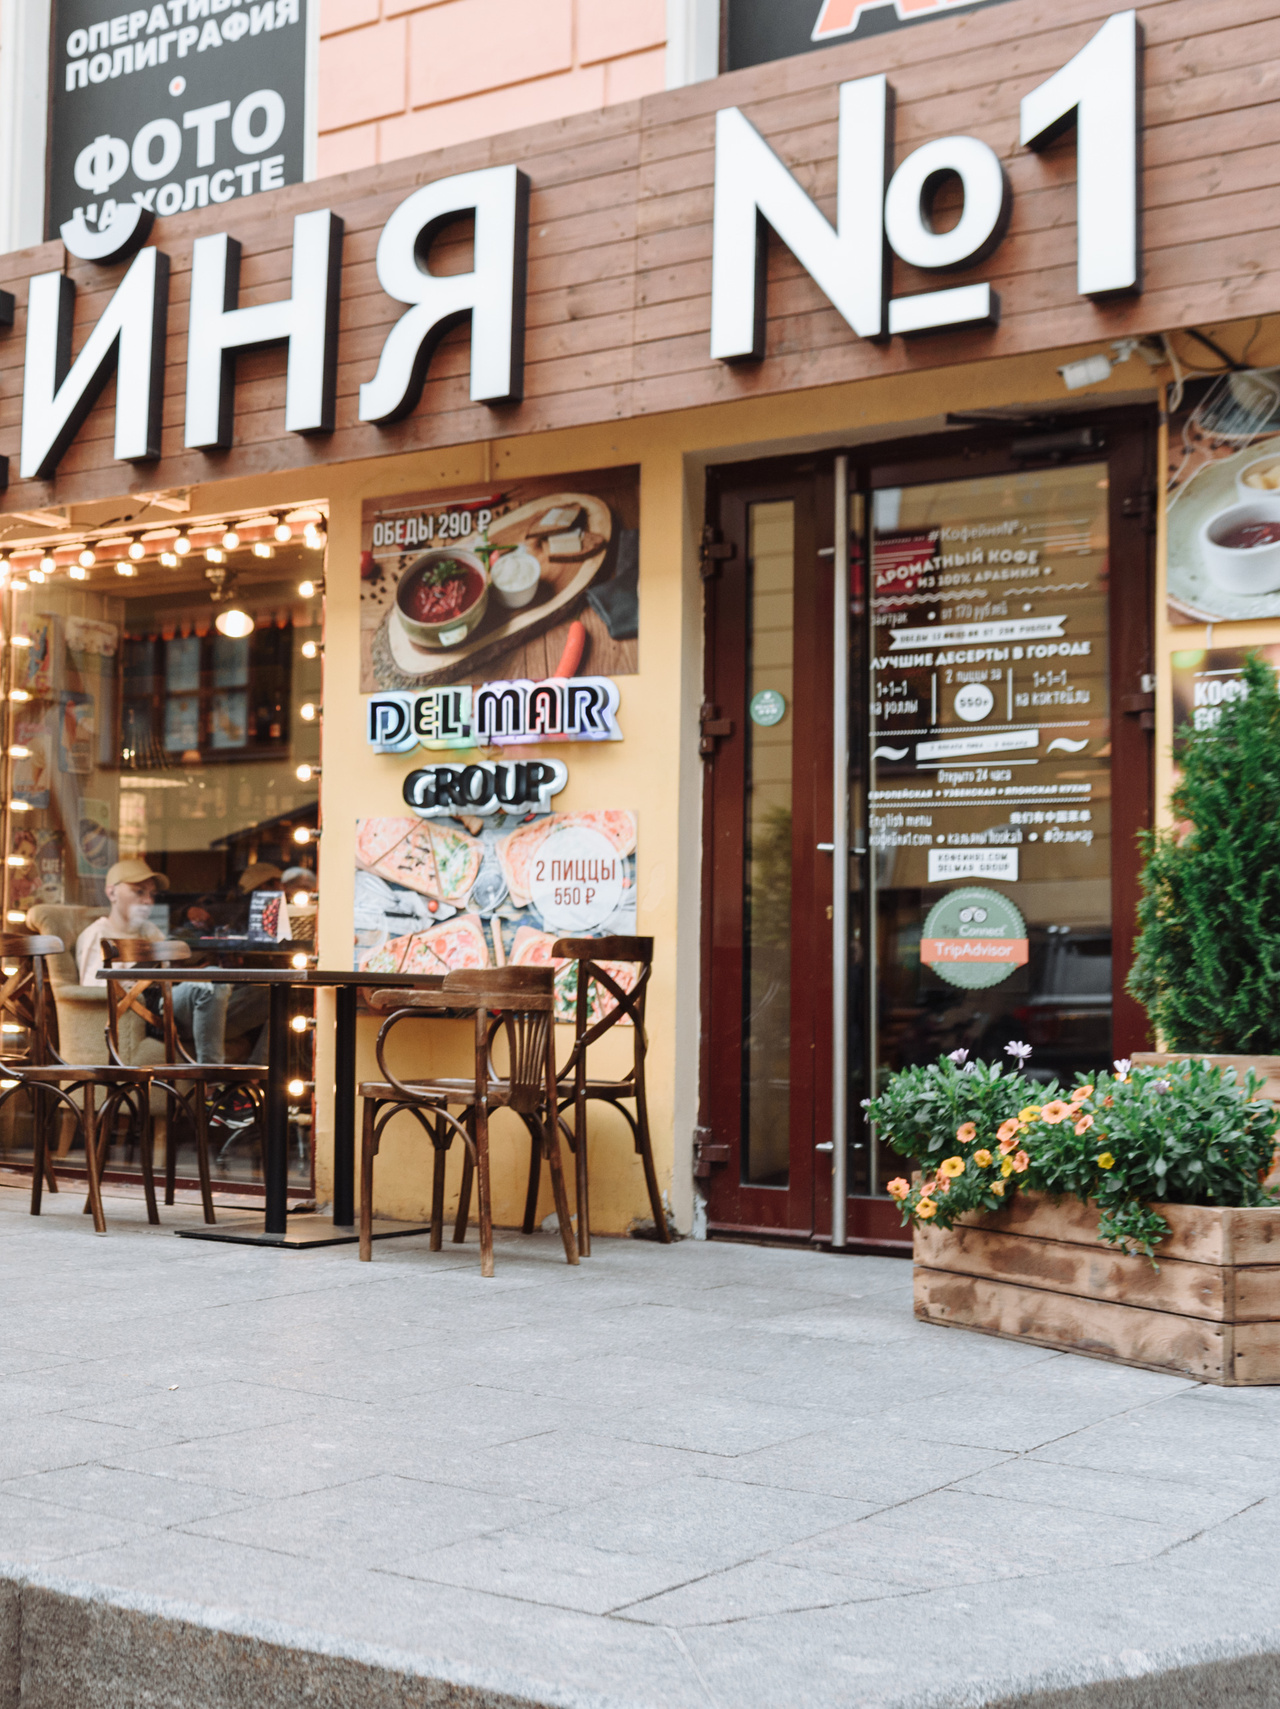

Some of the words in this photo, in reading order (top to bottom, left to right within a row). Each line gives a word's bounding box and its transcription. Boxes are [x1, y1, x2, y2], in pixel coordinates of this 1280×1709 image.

[66, 0, 262, 58] ОПЕРАТИВ
[65, 0, 300, 92] ПОЛИГРАФИЯ
[74, 89, 286, 195] ФОТО
[373, 516, 434, 547] ОБЕДЫ
[438, 511, 472, 539] 290
[876, 547, 984, 588] АРОМАТНЫЙ
[988, 549, 1039, 566] КОФЕ
[918, 576, 936, 589] ИЗ
[937, 572, 971, 587] 100%
[974, 567, 1040, 583] АРАБИКИ
[869, 652, 934, 671] ЛУЧШИЕ
[935, 647, 1010, 667] ДЕСЕРТЫ
[1012, 646, 1024, 659] В
[1026, 641, 1092, 658] ГОРОДЕ
[945, 670, 954, 684] 2
[1032, 670, 1068, 687] 1+1=1
[1031, 686, 1091, 706] коктейли
[367, 687, 465, 746] DEL
[474, 680, 614, 738] MAR
[402, 761, 558, 810] GROUP
[938, 768, 975, 787] Открыто
[976, 768, 989, 783] 24
[989, 769, 1012, 782] часа
[868, 788, 933, 800] ЕВРОПЕЙСКАЯ
[943, 786, 997, 798] УЗБЕКСКАЯ
[1004, 784, 1057, 797] ЯПОНСКАЯ
[1058, 783, 1092, 794] КУХНЯ
[905, 814, 933, 828] menu
[536, 860, 545, 881] 2
[551, 859, 616, 883] ПИЦЦЫ
[554, 887, 581, 906] 550
[934, 942, 1015, 960] TripAdvisor
